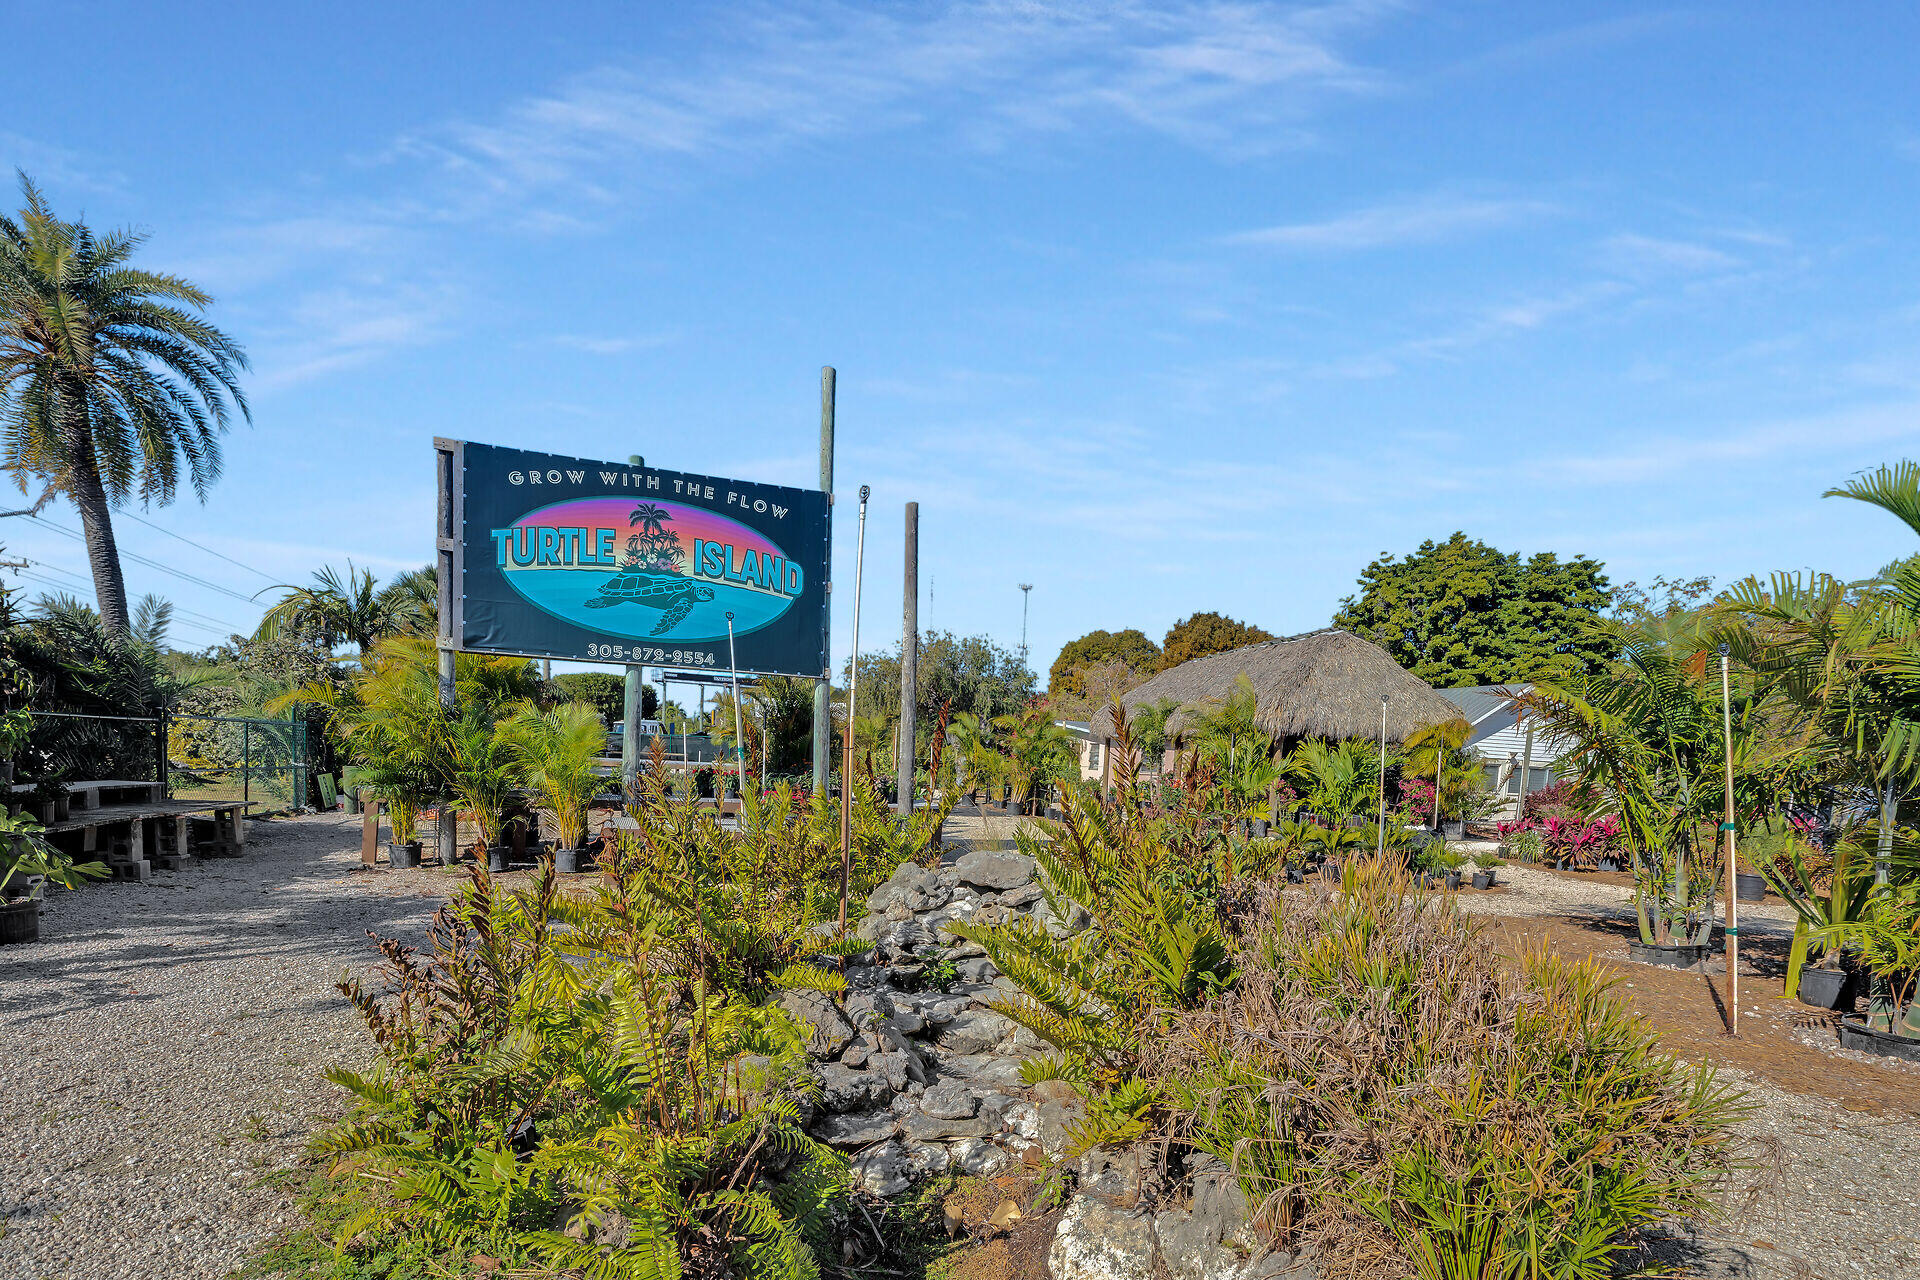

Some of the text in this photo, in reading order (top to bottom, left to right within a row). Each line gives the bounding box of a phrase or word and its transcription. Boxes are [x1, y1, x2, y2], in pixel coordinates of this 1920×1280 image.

[508, 469, 788, 519] GROW WITH THE FLOW
[490, 526, 804, 597] TURTLE ISLAND
[587, 643, 715, 665] 305-872-2554
